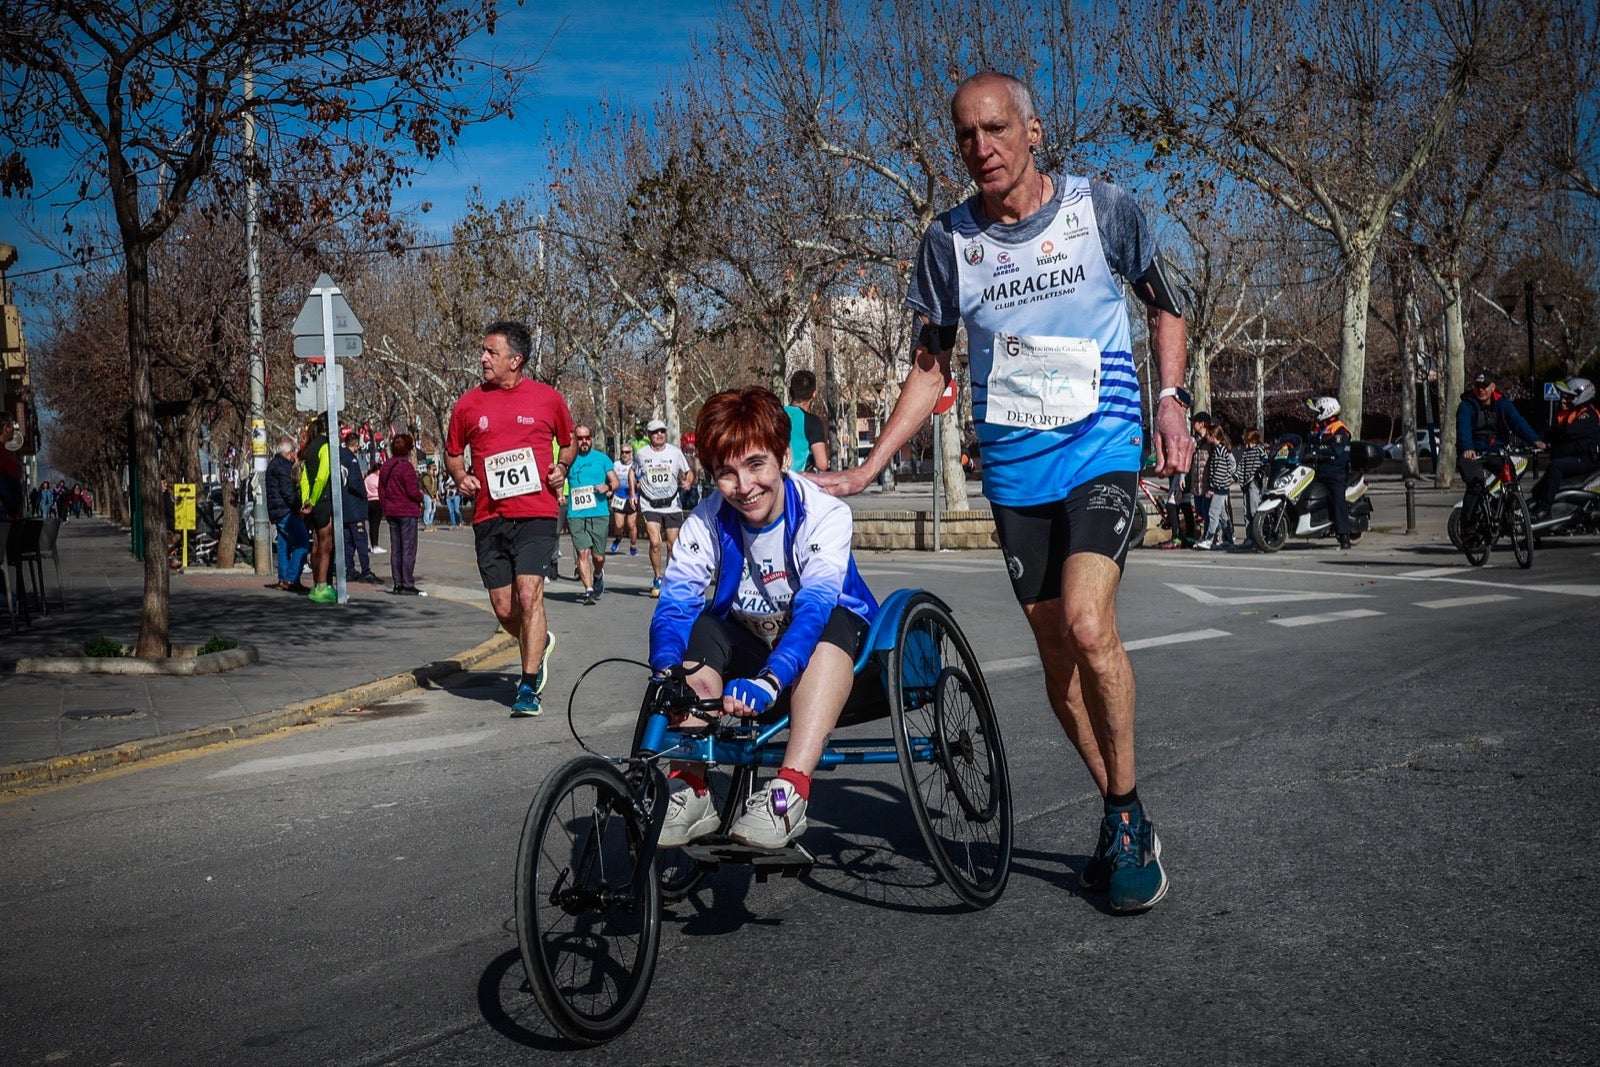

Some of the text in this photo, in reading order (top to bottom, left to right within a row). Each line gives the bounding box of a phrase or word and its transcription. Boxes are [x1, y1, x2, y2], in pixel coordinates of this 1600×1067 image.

[980, 264, 1086, 304] MARACENA
[994, 287, 1076, 311] CLUB DE ATLETISMO
[1007, 410, 1075, 426] DEPORTES
[495, 453, 525, 466] FONDO
[495, 465, 530, 488] 761
[652, 473, 669, 483] 802
[575, 494, 592, 505] 803
